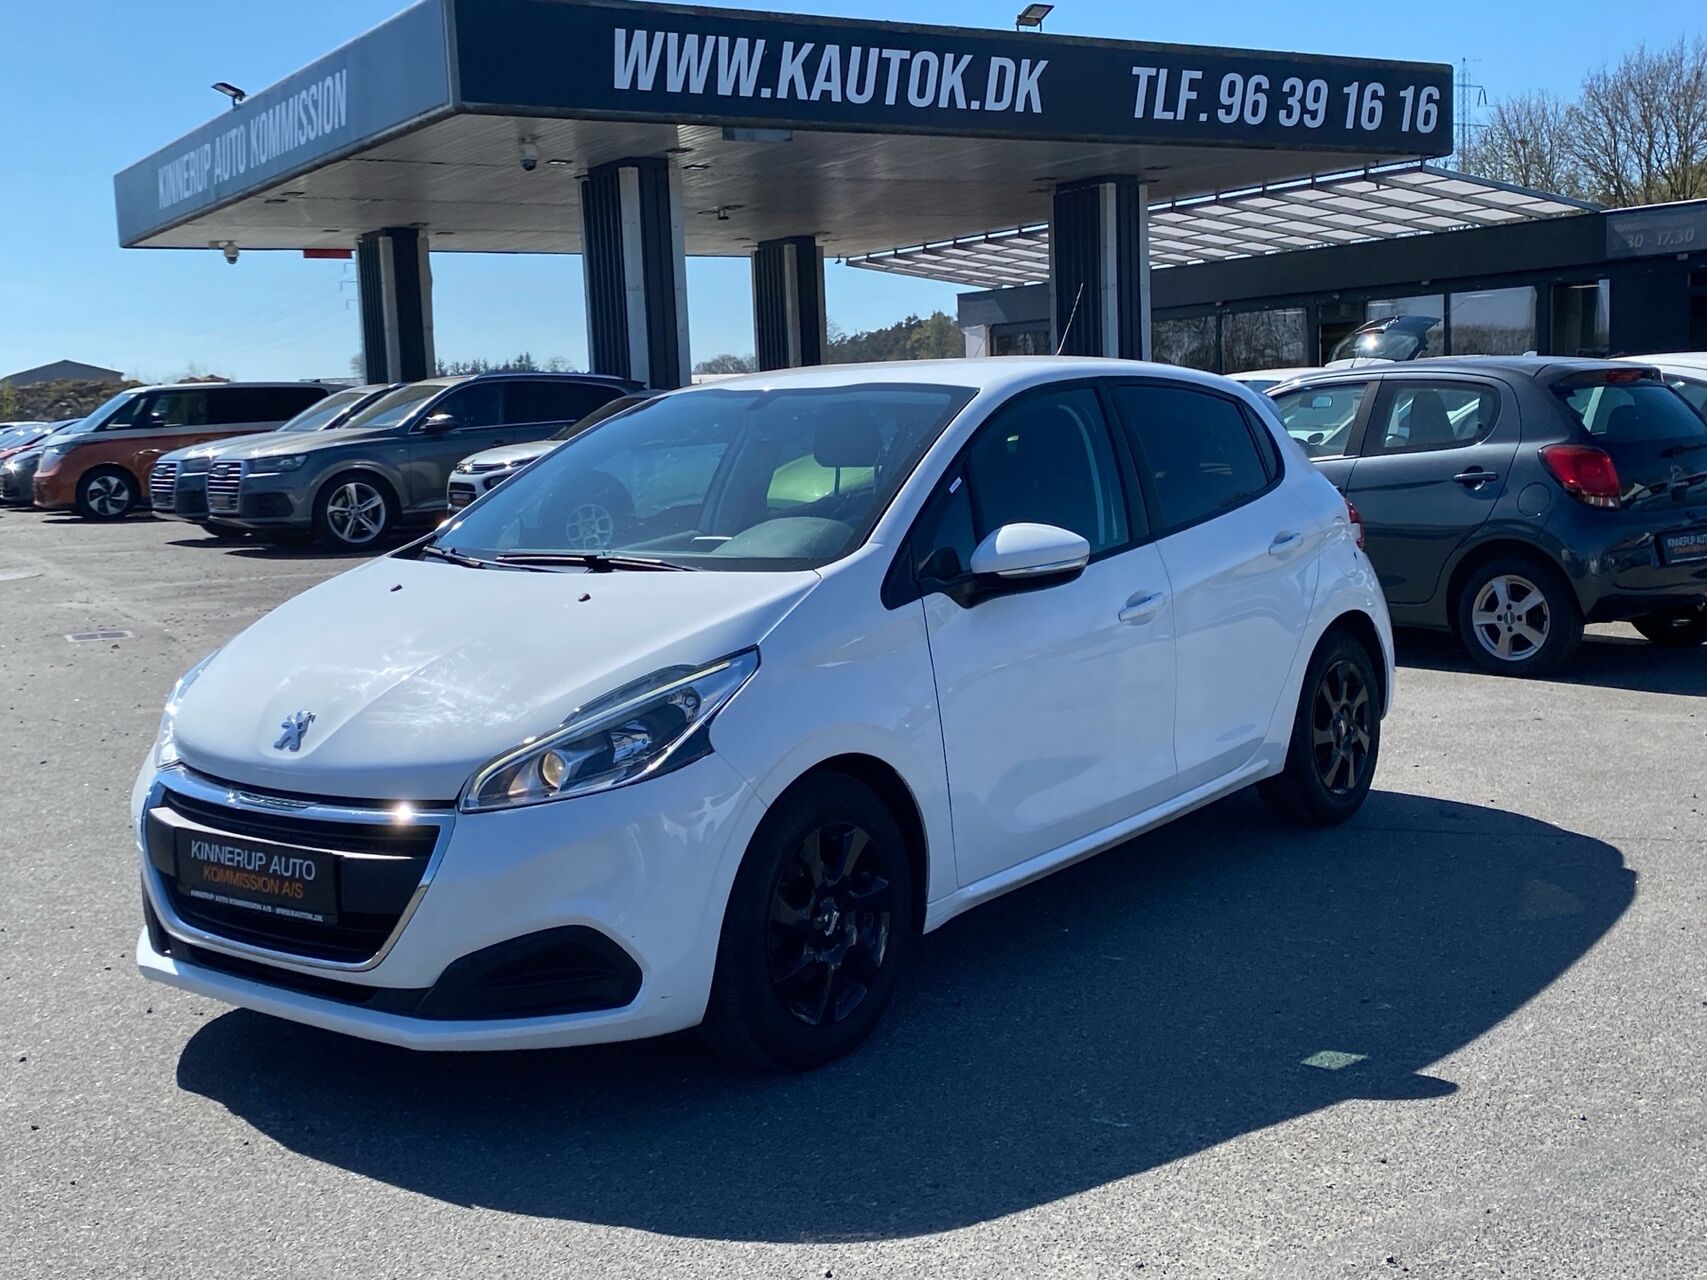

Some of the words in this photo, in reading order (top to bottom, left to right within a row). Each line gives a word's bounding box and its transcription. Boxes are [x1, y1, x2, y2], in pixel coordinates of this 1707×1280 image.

[613, 28, 1049, 114] WWW.KAUTOK.DK
[1131, 66, 1208, 122] TLF.
[1217, 72, 1270, 125] 96
[1278, 77, 1329, 129] 39
[1343, 81, 1385, 132] 16
[1399, 85, 1440, 134] 16
[158, 143, 212, 210] KINNERUP
[214, 124, 247, 185] AUTO
[250, 69, 347, 169] KOMMISSION
[190, 840, 266, 871] KINNERUP
[269, 855, 316, 881] AUTO
[203, 865, 280, 894] KOMMISSION
[282, 882, 304, 899] A/S
